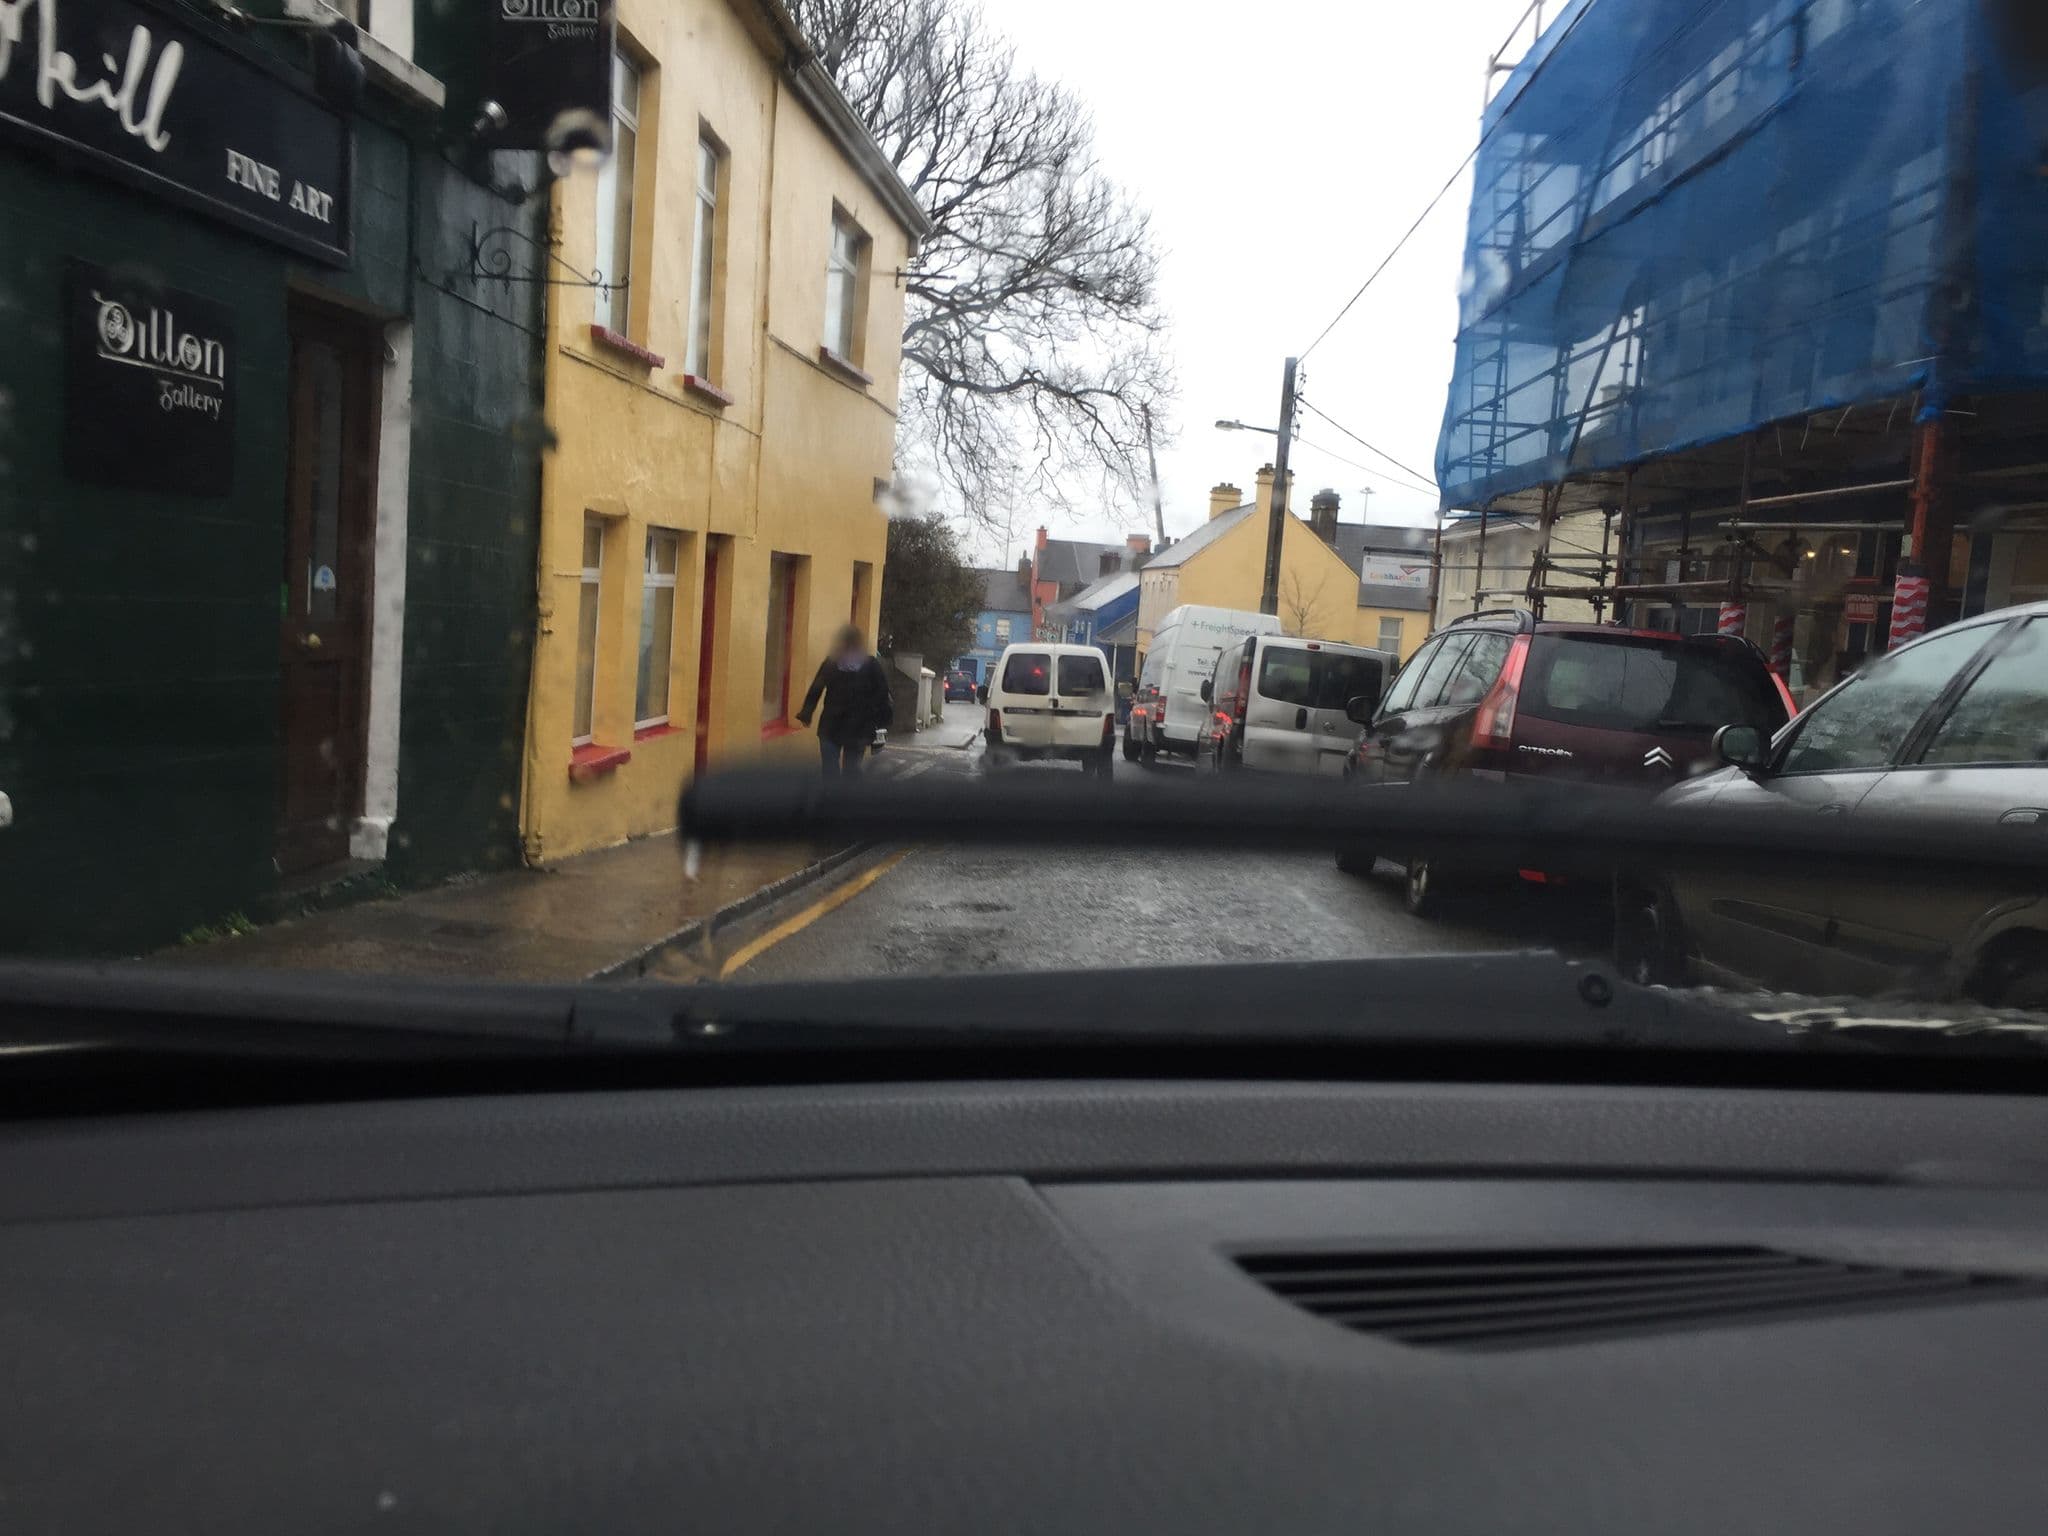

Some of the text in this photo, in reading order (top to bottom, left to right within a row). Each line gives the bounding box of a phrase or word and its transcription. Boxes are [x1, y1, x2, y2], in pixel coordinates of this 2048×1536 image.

[547, 23, 595, 40] Gallery
[224, 147, 334, 224] FINE ART
[91, 289, 224, 379] Dillon
[158, 379, 223, 421] Gallery
